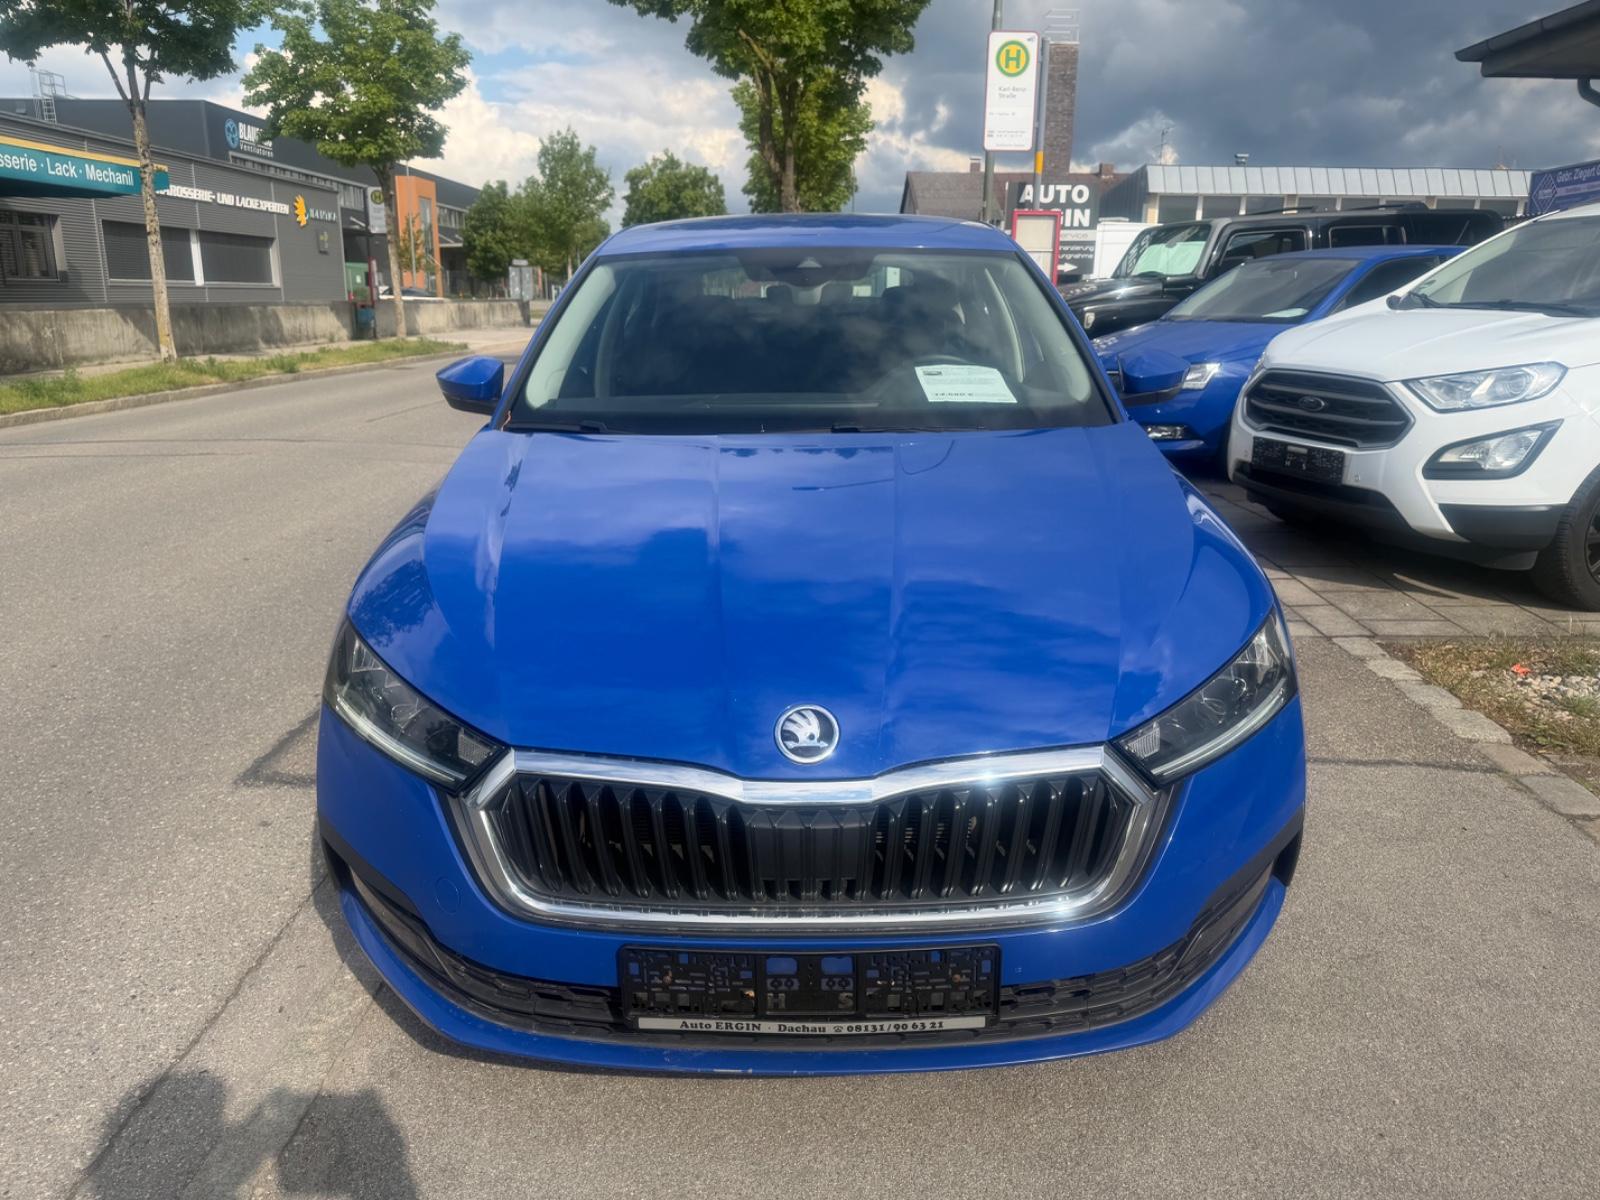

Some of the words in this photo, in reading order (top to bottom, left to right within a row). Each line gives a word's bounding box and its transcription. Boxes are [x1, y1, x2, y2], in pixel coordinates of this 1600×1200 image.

[1005, 49, 1021, 69] H
[46, 157, 78, 178] Lack
[155, 184, 216, 203] ROSSERIE-
[216, 192, 235, 206] UND
[1019, 184, 1090, 204] AUTO
[680, 1020, 712, 1030] Auto
[715, 1021, 762, 1032] ERGIN
[778, 1023, 826, 1033] Dachau
[847, 1022, 908, 1033] 08131/90
[911, 1021, 926, 1030] 63
[929, 1021, 944, 1029] 21
